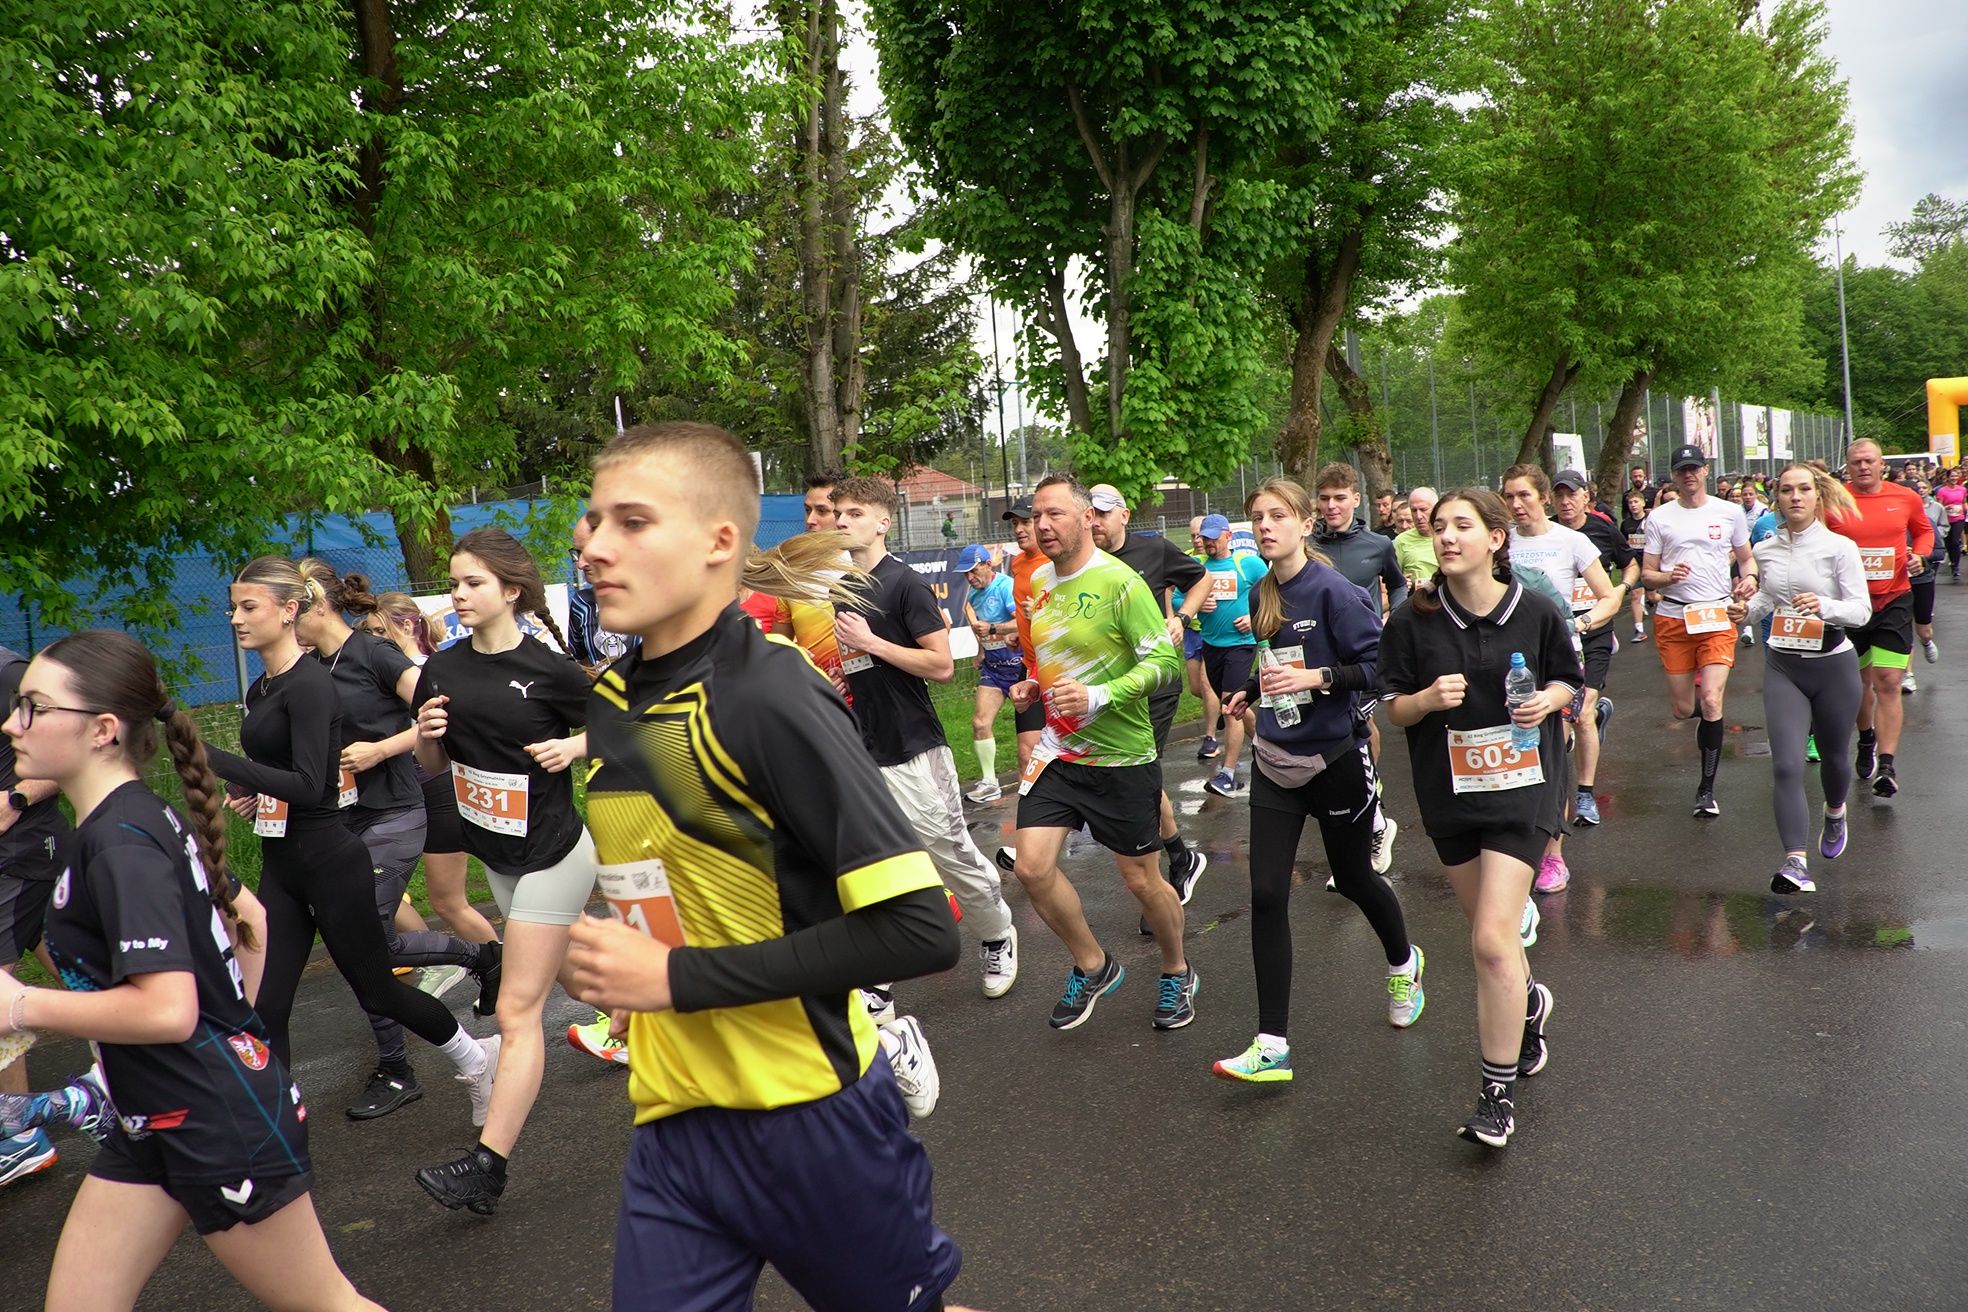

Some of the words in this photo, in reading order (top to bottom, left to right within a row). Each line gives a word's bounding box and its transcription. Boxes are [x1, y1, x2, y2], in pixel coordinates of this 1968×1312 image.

[1698, 608, 1717, 621] 14
[1783, 618, 1807, 634] 87
[1465, 742, 1521, 769] 603
[466, 782, 508, 812] 231
